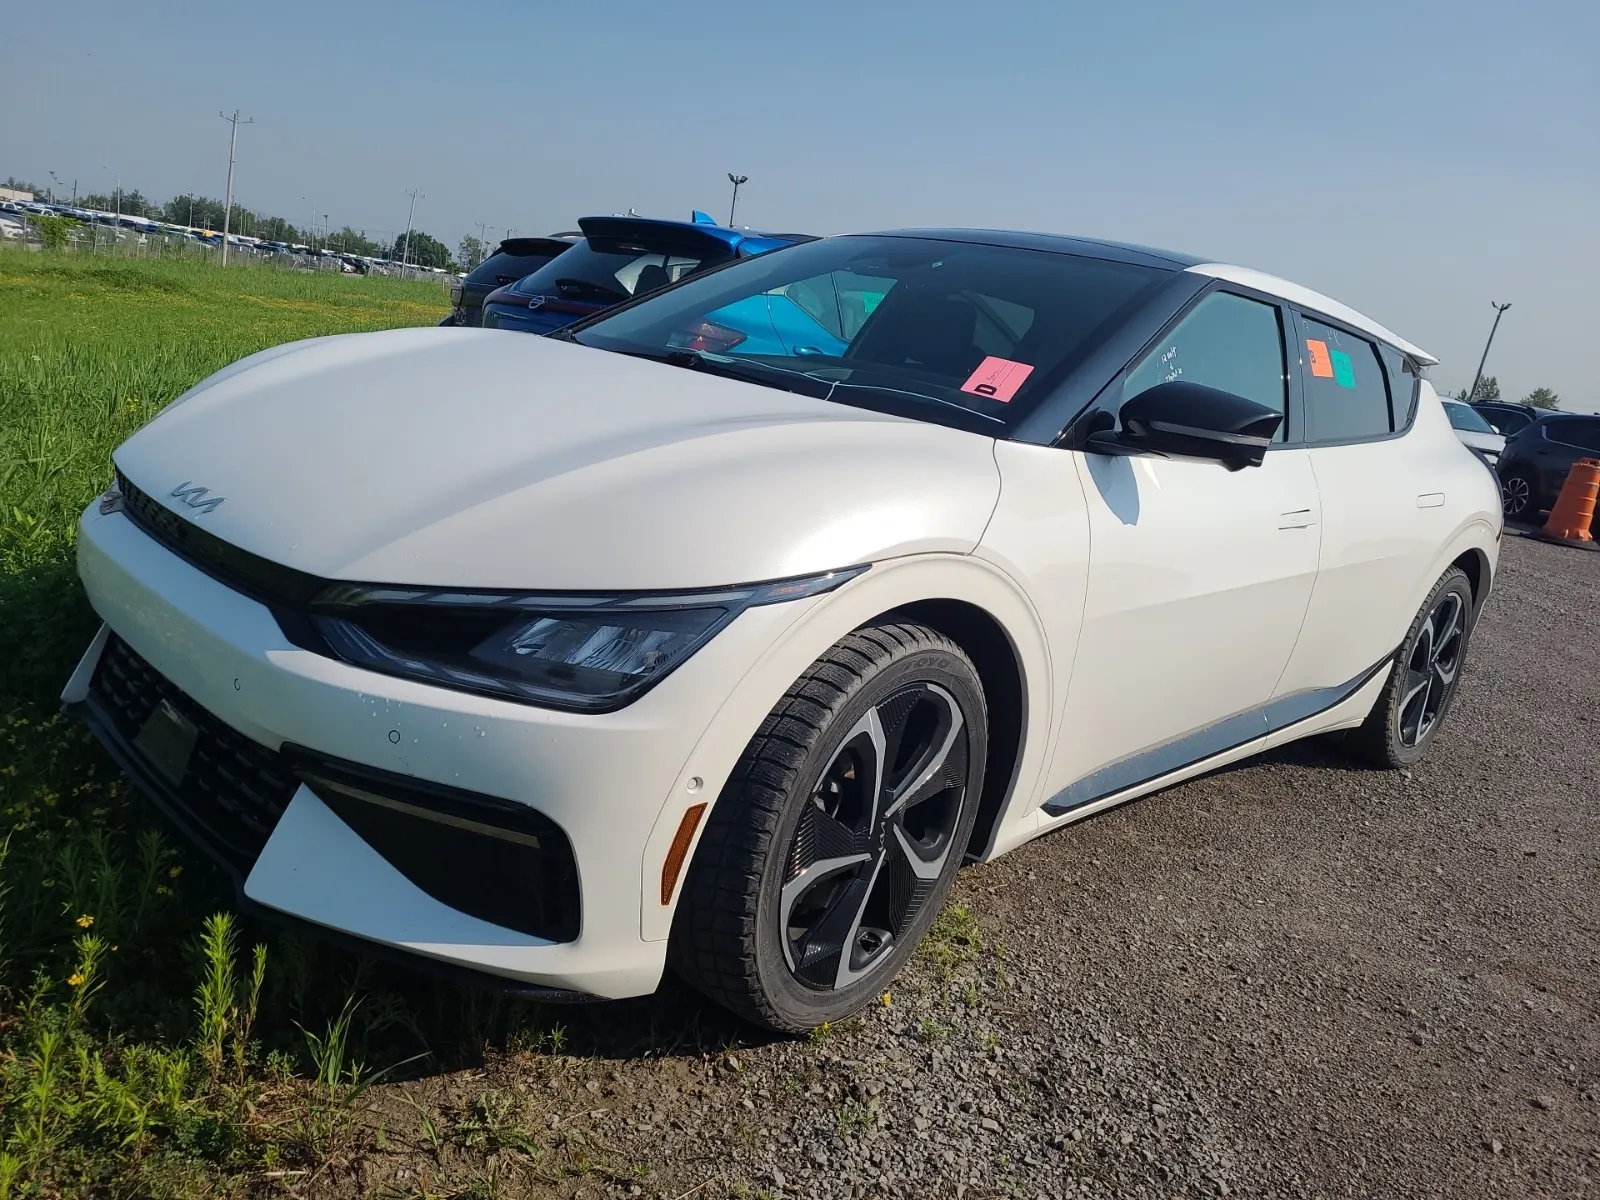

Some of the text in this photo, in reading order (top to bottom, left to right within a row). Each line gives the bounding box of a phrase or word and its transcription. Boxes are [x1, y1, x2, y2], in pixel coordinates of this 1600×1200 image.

[1309, 350, 1316, 363] B
[974, 384, 998, 396] D
[902, 657, 951, 671] TOYO
